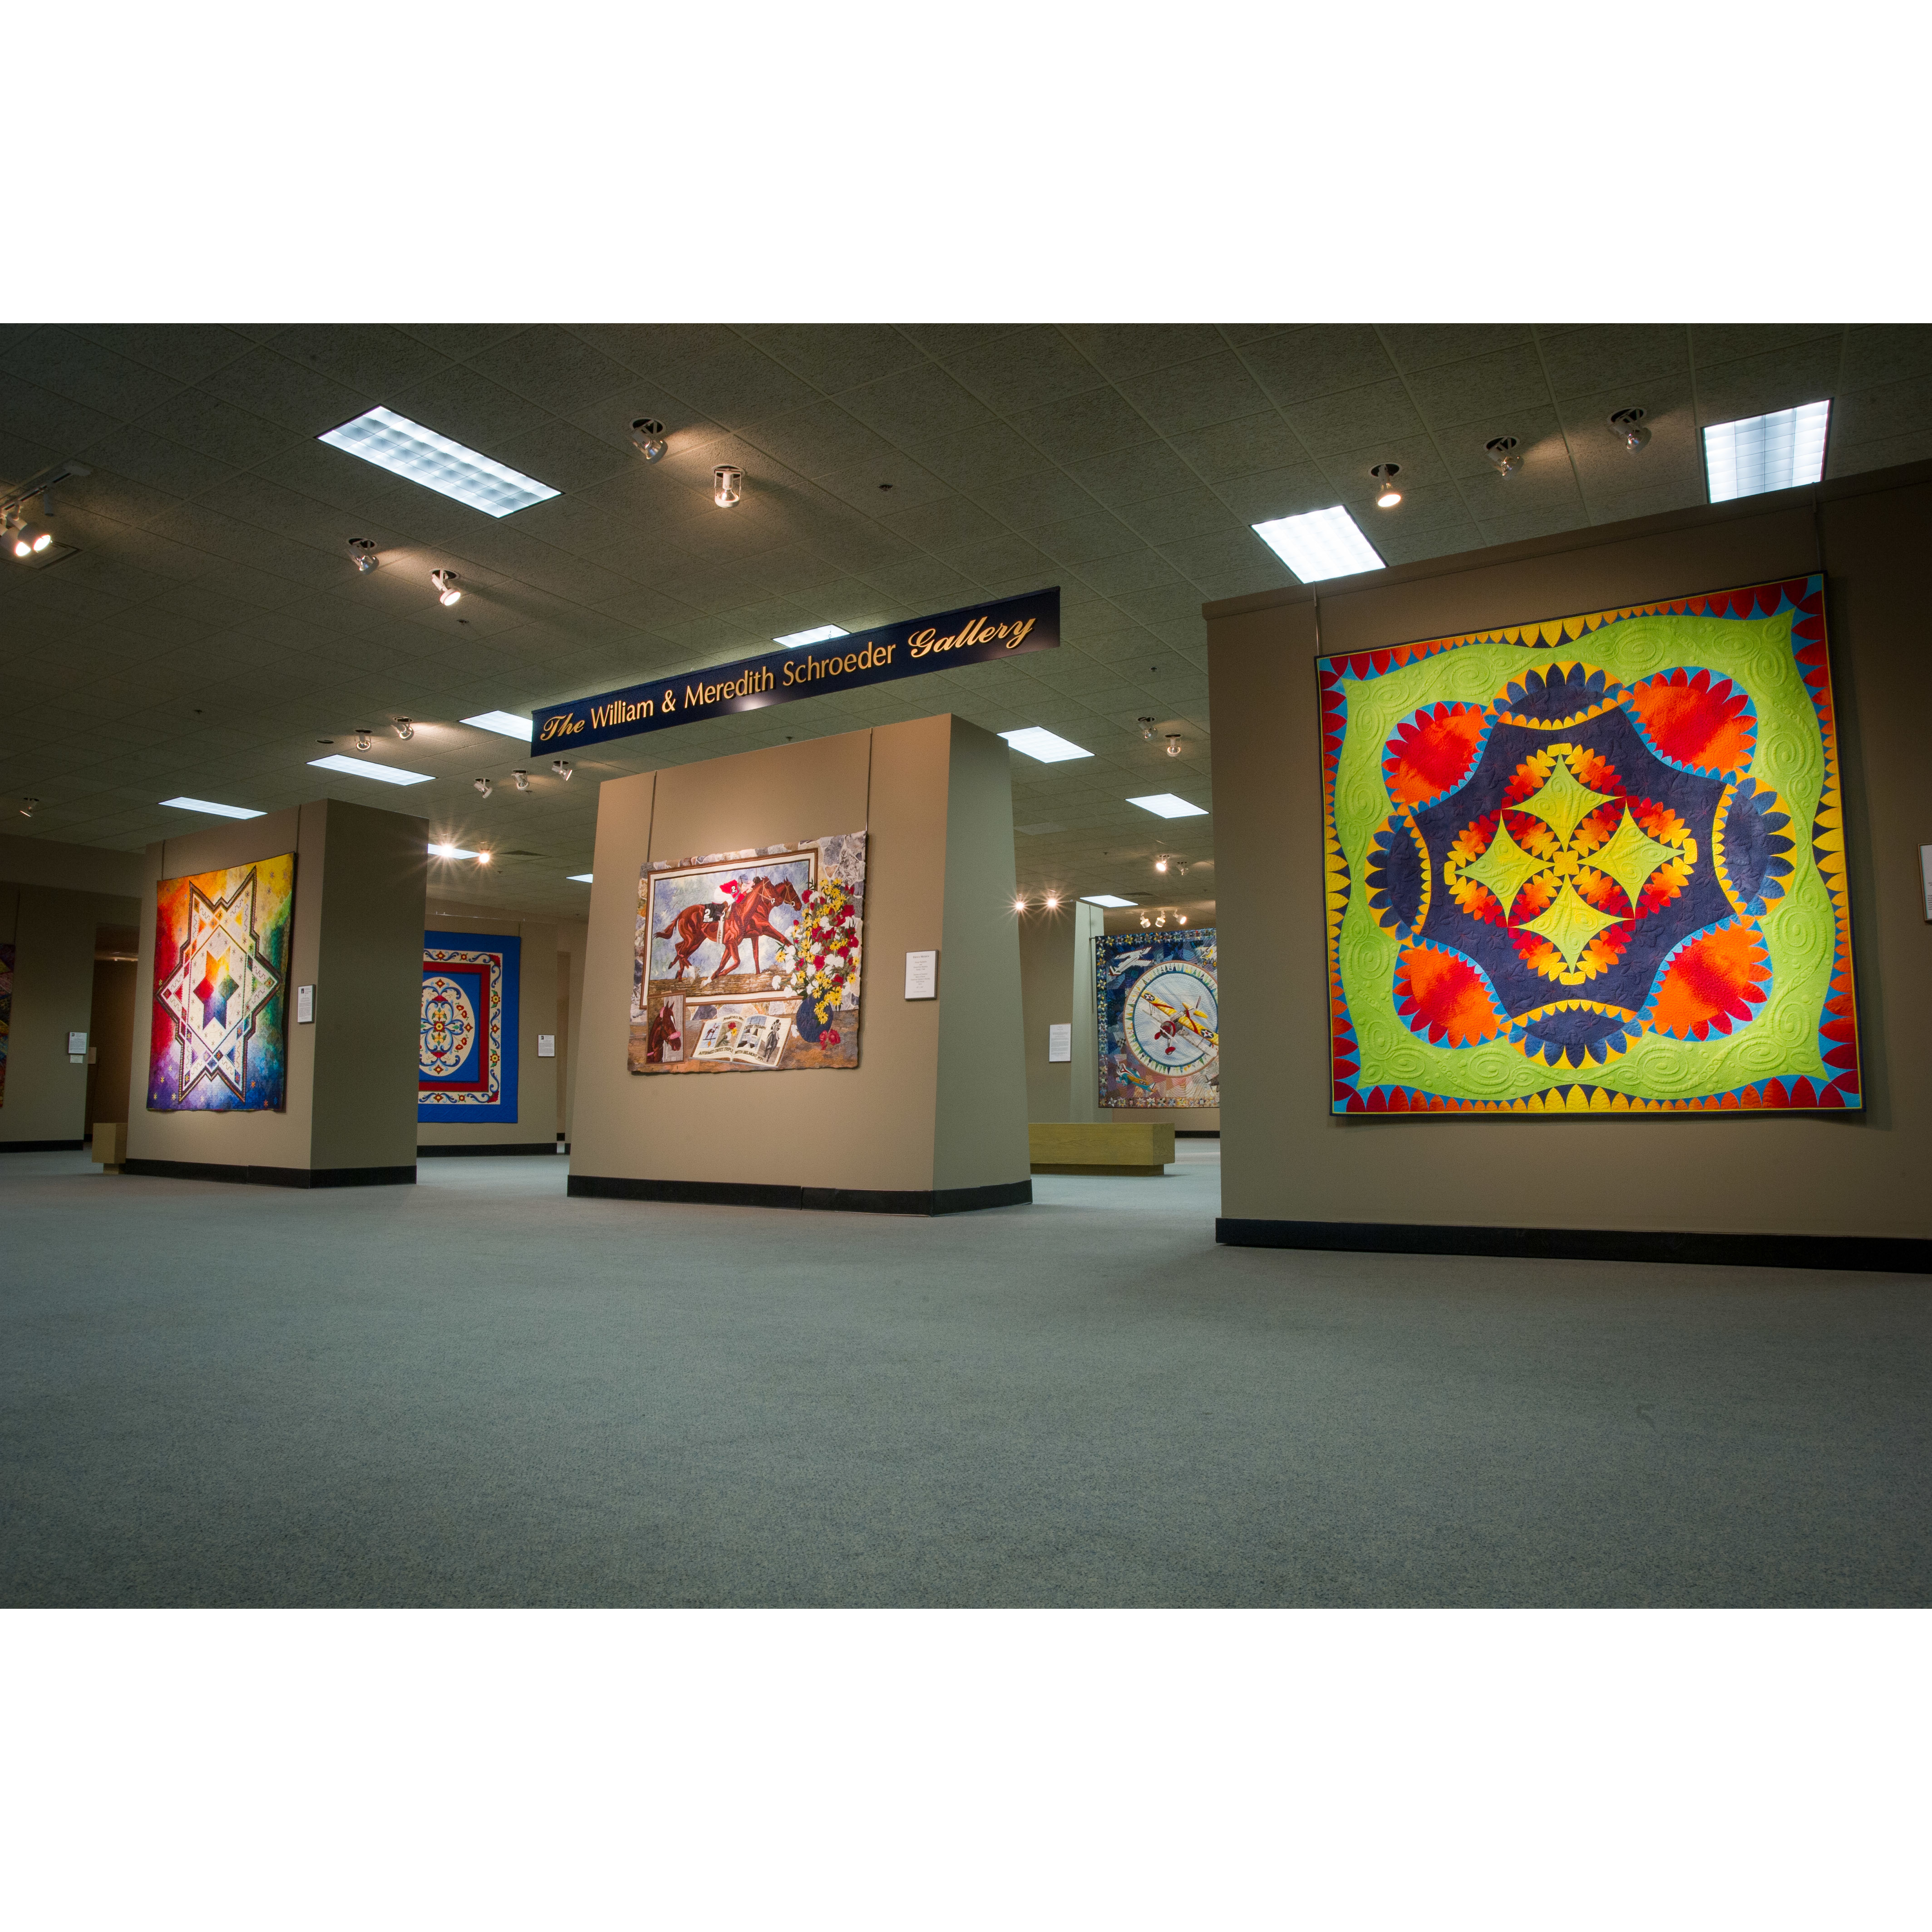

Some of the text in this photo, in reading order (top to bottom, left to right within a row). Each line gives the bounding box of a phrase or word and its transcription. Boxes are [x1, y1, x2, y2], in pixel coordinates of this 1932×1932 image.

[540, 616, 1036, 740] The William & Meredith Schroeder Gallery
[704, 909, 710, 918] 2
